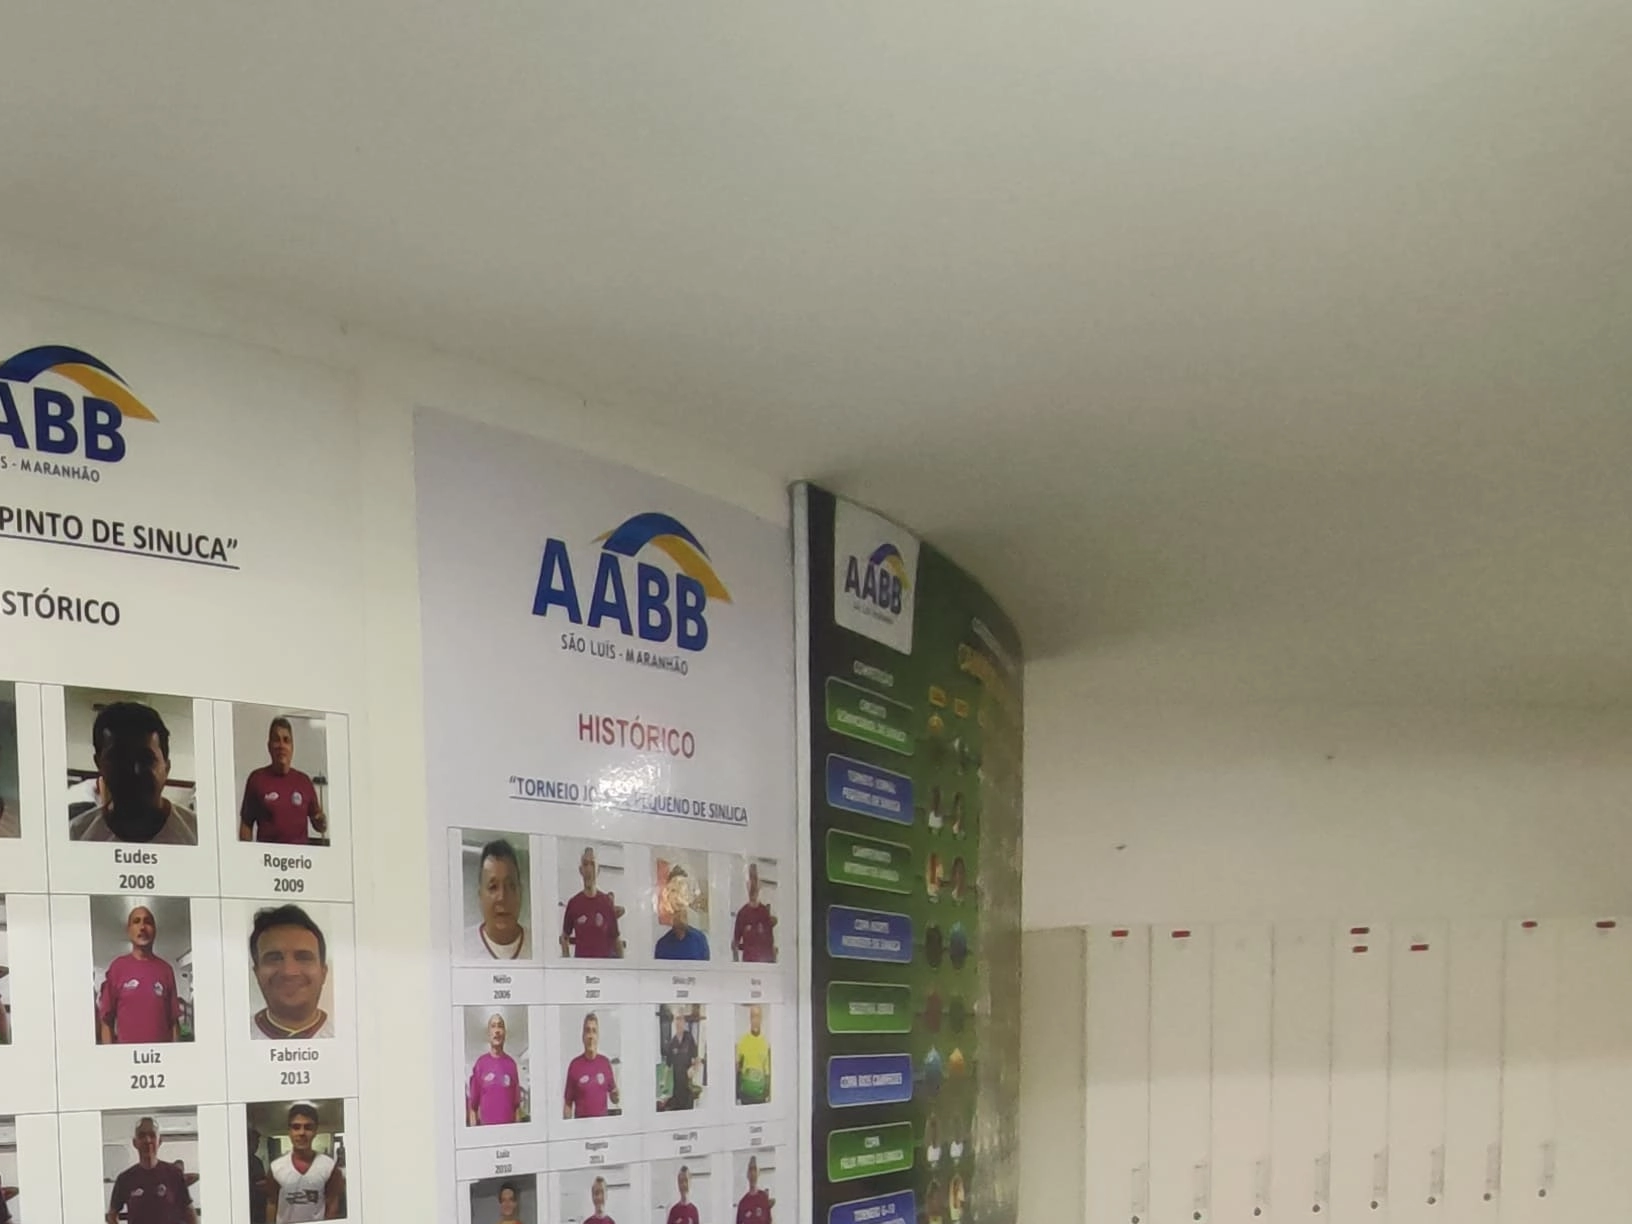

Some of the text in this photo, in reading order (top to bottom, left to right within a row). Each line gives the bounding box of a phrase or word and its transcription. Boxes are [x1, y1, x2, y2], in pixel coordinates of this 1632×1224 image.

[20, 458, 100, 483] MARANHÃO
[92, 519, 126, 547] DE
[845, 556, 902, 615] AABB
[532, 537, 708, 651] AABB
[561, 633, 586, 653] SÃO
[590, 639, 616, 659] LUÍS
[625, 651, 688, 675] MARANHÃO
[578, 713, 695, 759] HISTÓRICO
[692, 801, 707, 818] DE
[114, 849, 158, 865] Eudes
[263, 854, 312, 870] Rogerio
[119, 874, 155, 889] 2008
[273, 878, 305, 893] 2009
[133, 1049, 161, 1064] Luiz
[270, 1047, 319, 1062] Fabricio
[130, 1074, 166, 1089] 2012
[280, 1071, 311, 1085] 2013
